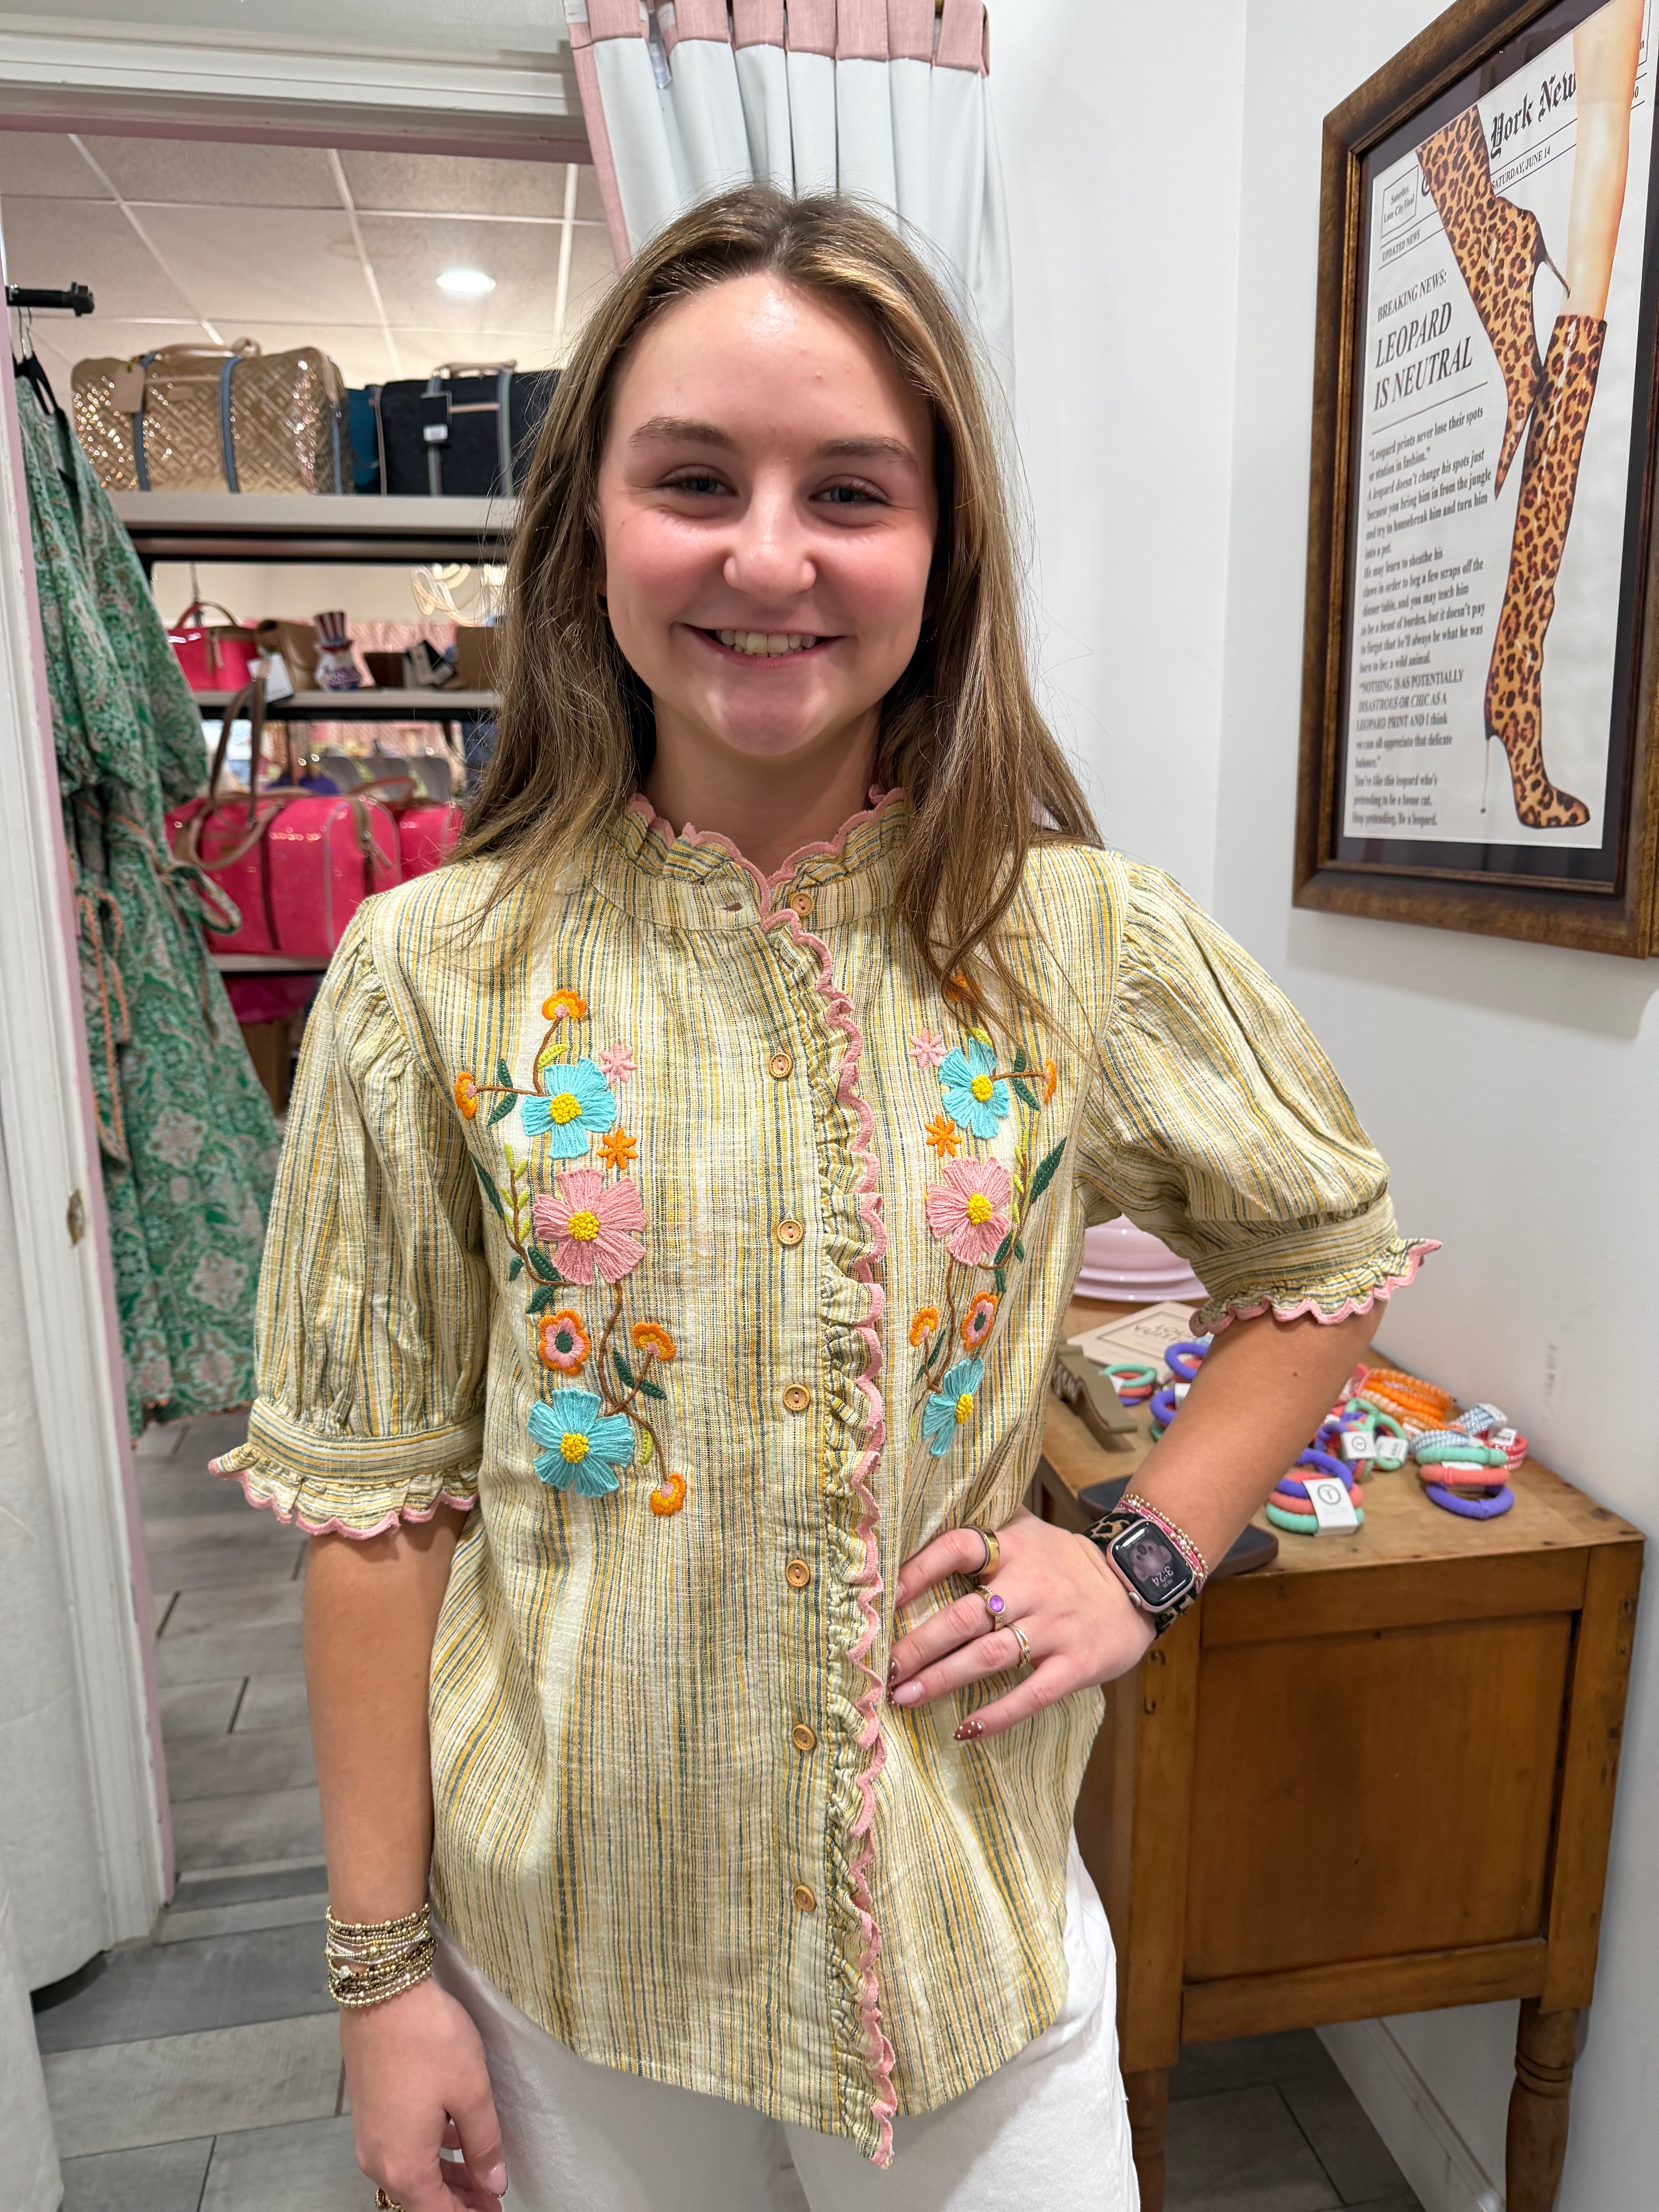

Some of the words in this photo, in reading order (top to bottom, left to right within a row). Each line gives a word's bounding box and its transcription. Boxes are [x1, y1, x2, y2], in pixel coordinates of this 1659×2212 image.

[1491, 93, 1533, 159] York
[1491, 162, 1525, 191] SATURDAY,
[1525, 151, 1543, 170] JUNE
[1544, 145, 1551, 160] 14
[1382, 240, 1405, 261] UPDATED
[1406, 229, 1420, 247] NEWS
[1378, 285, 1417, 322] BREAKING
[1419, 269, 1446, 298] NEWS:
[1375, 302, 1452, 369] LEOPARD
[1373, 378, 1389, 412] IS
[1392, 336, 1472, 403] NEUTRAL
[1396, 434, 1415, 455] prints
[1417, 428, 1433, 443] never
[1434, 422, 1447, 436] lose
[1449, 412, 1465, 431] their
[1466, 406, 1483, 426] spots
[1396, 458, 1402, 472] in
[1418, 466, 1440, 483] change
[1441, 460, 1451, 475] his
[1452, 454, 1469, 474] spots
[1470, 448, 1484, 468] just
[1401, 494, 1417, 509] bring
[1418, 489, 1430, 504] him
[1431, 485, 1438, 500] in
[1440, 482, 1456, 497] from
[1457, 475, 1468, 491] the
[1469, 467, 1491, 491] jungle
[1429, 506, 1441, 521] him
[1443, 499, 1456, 516] and
[1457, 498, 1472, 513] turn
[1474, 491, 1487, 507] him
[1462, 557, 1472, 575] off
[1473, 556, 1484, 572] the
[1471, 602, 1485, 619] pay
[1411, 669, 1464, 688] POTENTIALLY
[1411, 693, 1430, 708] CHIC
[1430, 692, 1440, 706] AS
[1440, 692, 1447, 705] A
[1409, 713, 1425, 728] AND
[1151, 1566, 1173, 1587] 3:24
